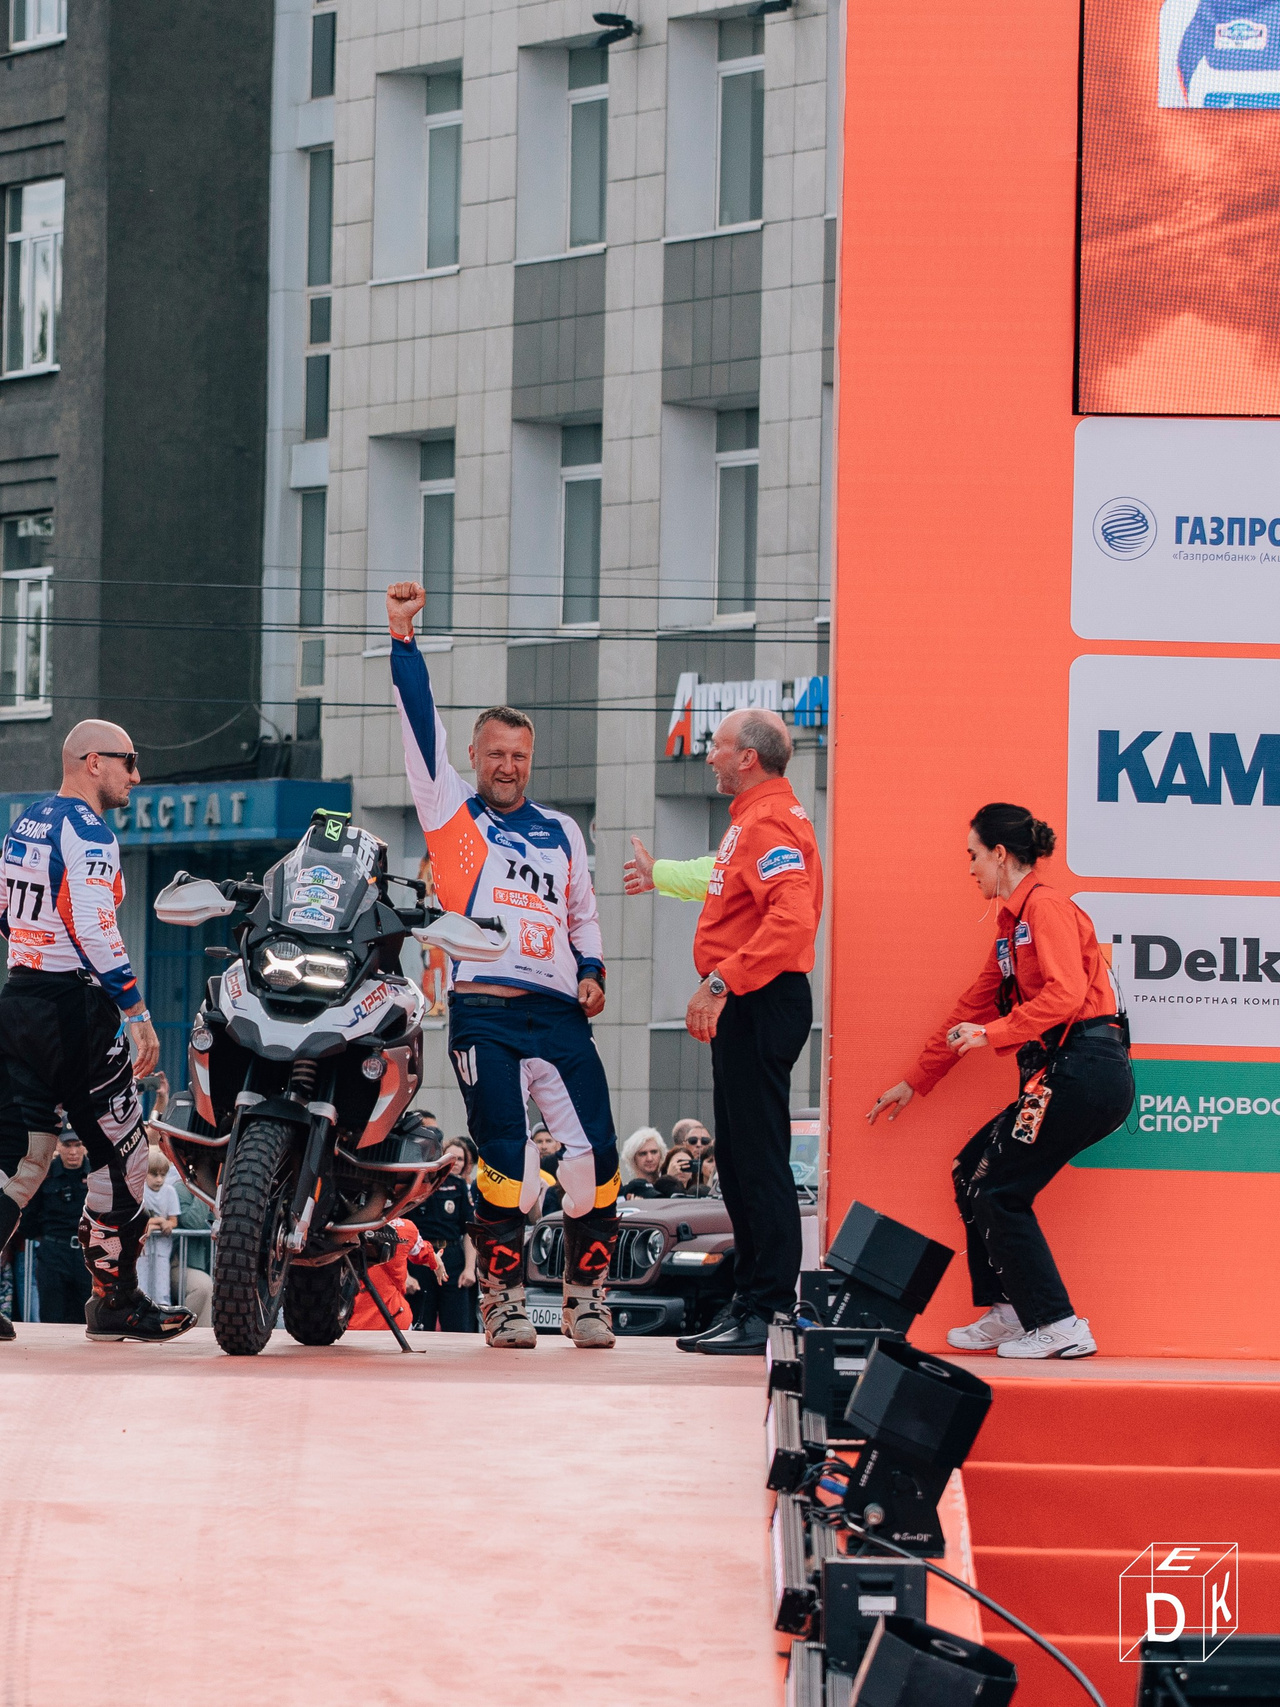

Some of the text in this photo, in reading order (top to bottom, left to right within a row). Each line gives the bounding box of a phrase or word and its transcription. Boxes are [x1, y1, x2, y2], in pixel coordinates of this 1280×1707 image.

[1172, 551, 1256, 563] «Газпромбанк»
[7, 878, 45, 920] 777
[509, 892, 528, 900] SILK
[510, 898, 528, 907] WAY
[1134, 994, 1237, 1005] ТРАНСПОРТНАЯ
[1140, 1095, 1192, 1113] РИА
[1139, 1114, 1223, 1133] СПОРТ
